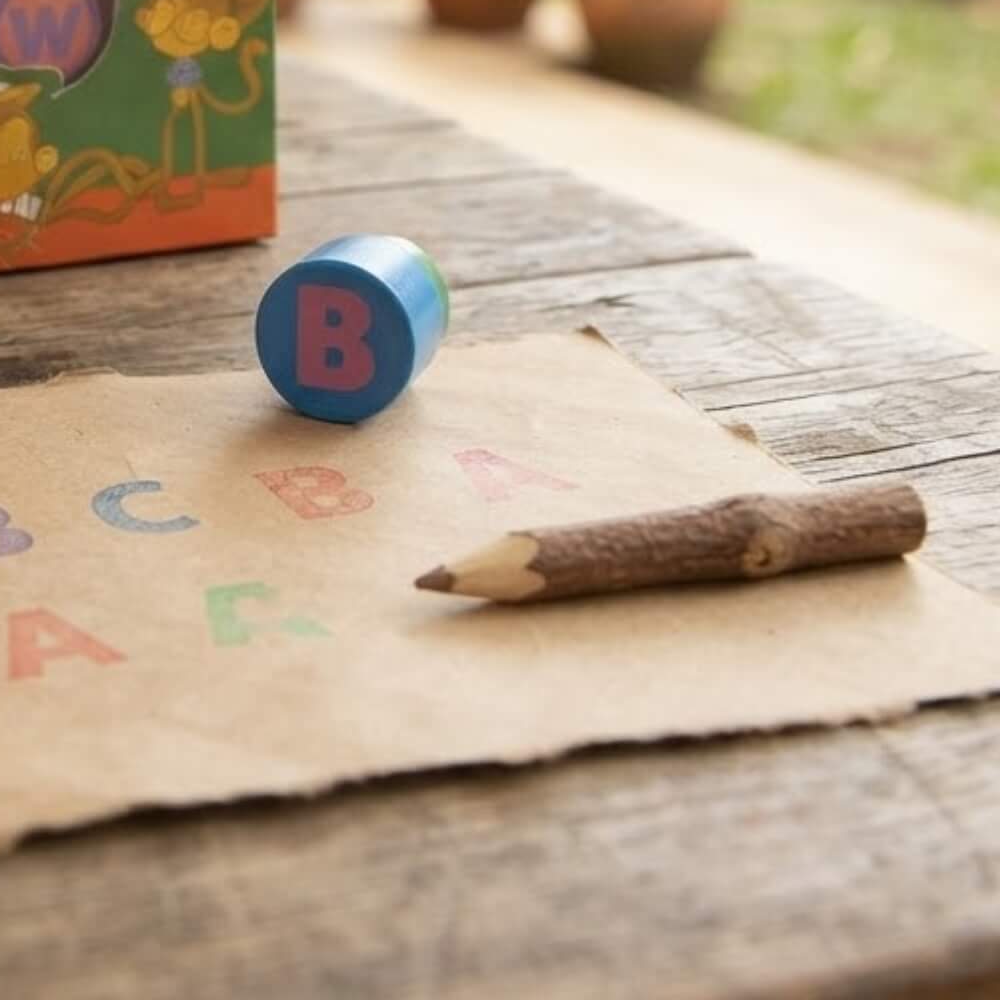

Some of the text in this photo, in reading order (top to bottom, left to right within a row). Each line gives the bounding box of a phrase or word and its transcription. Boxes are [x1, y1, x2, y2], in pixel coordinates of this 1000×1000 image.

[8, 4, 81, 59] W
[295, 283, 376, 393] B
[251, 465, 375, 521] B
[452, 447, 580, 502] A
[91, 479, 200, 534] C
[6, 606, 128, 681] A
